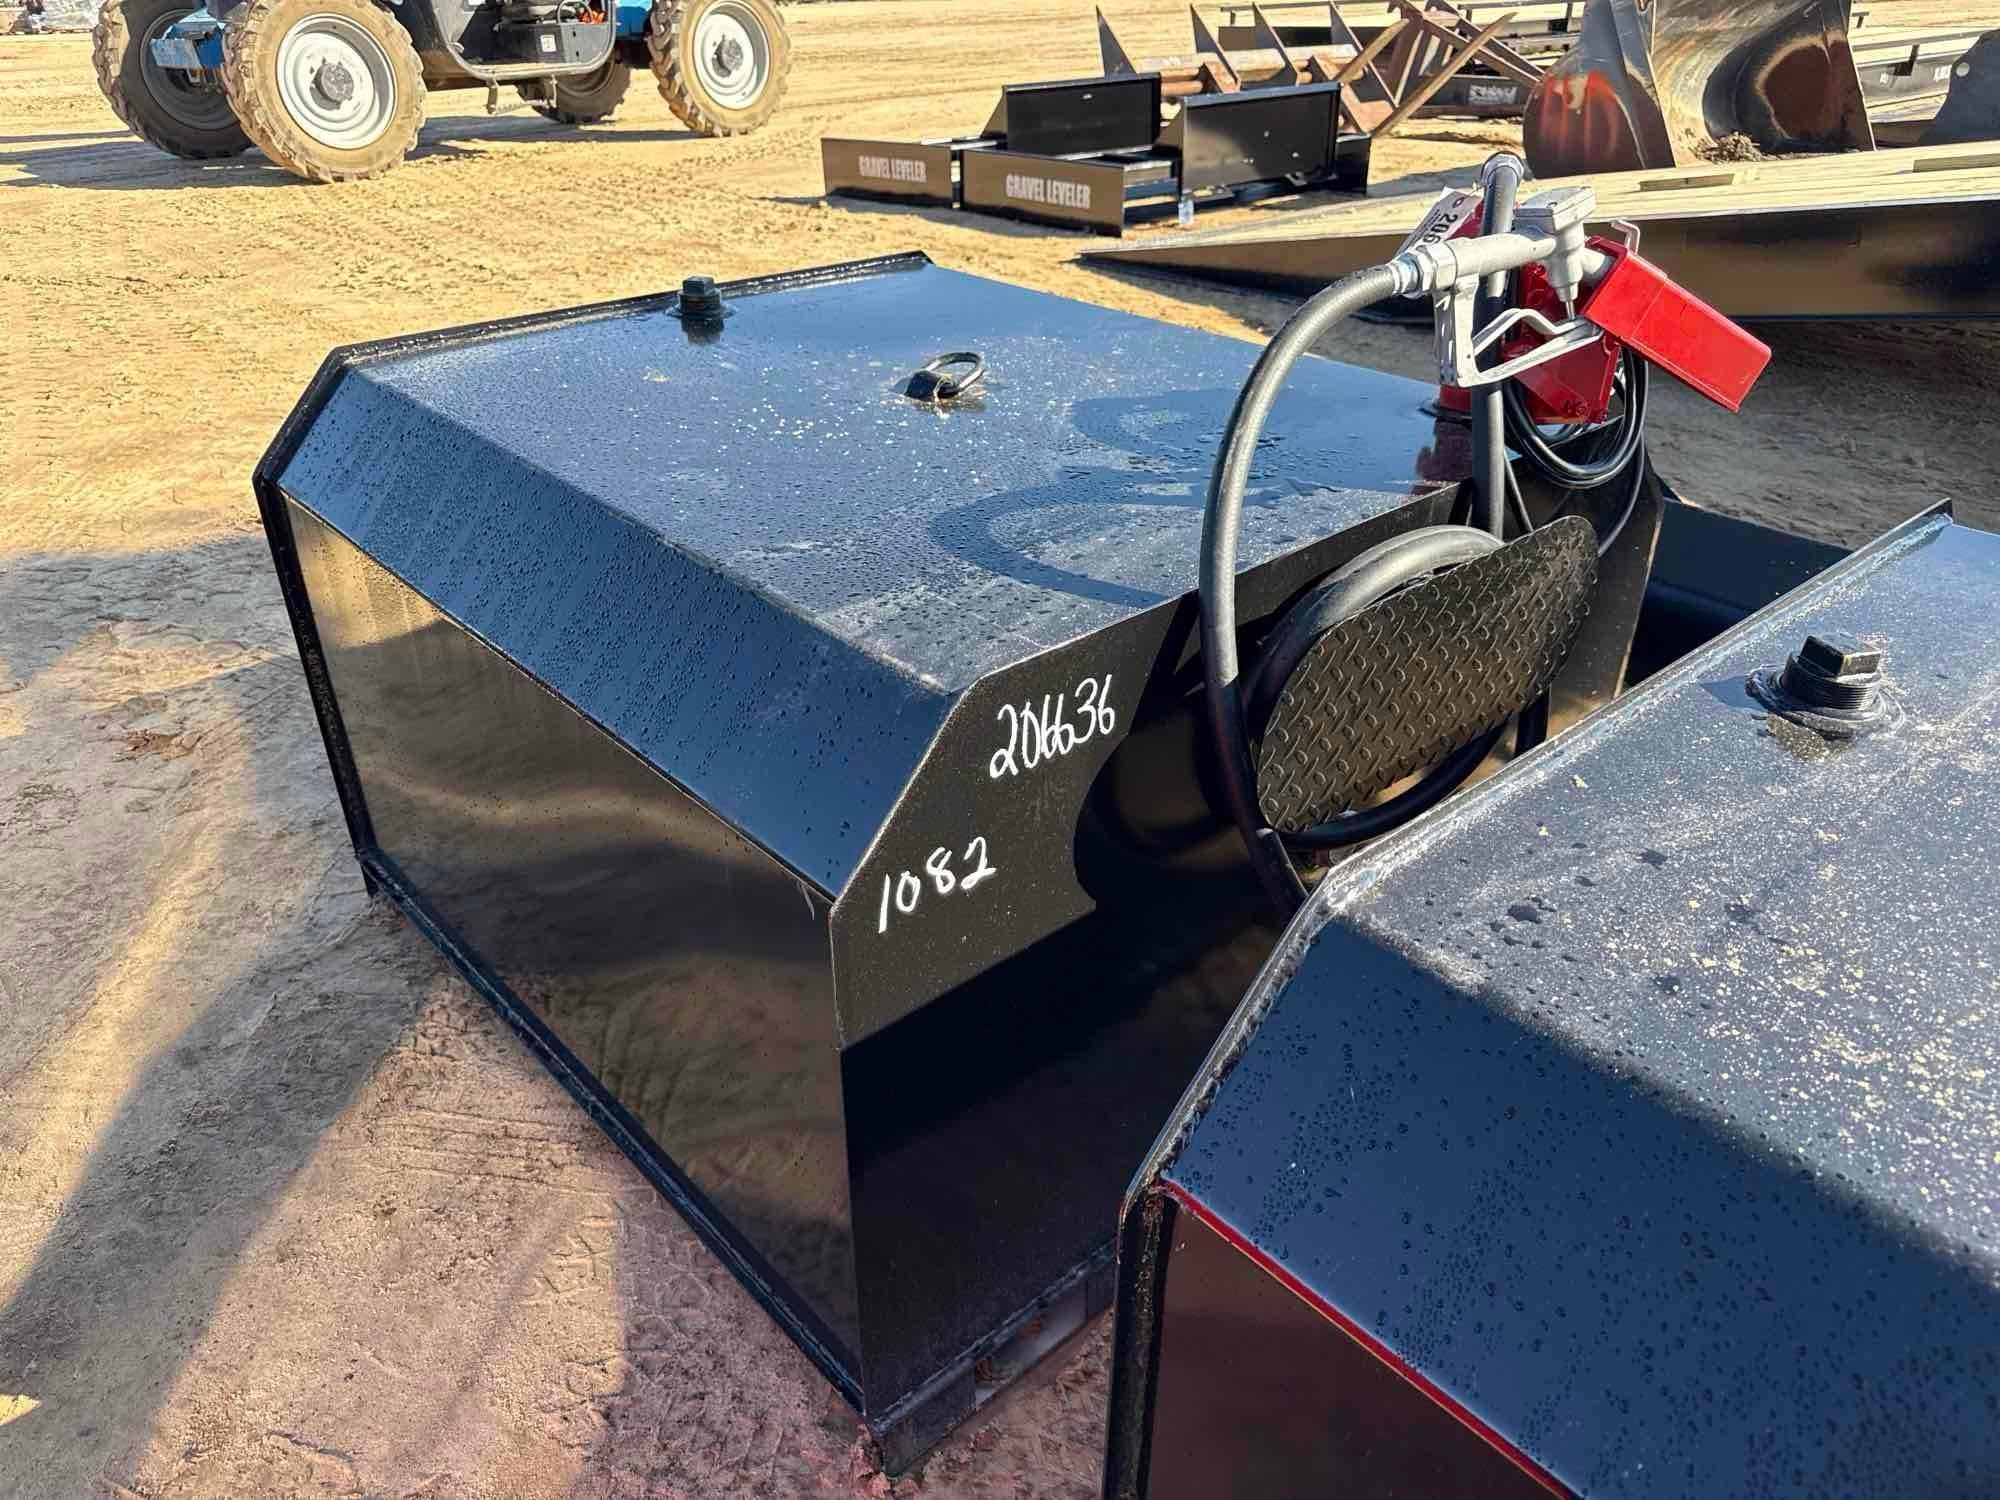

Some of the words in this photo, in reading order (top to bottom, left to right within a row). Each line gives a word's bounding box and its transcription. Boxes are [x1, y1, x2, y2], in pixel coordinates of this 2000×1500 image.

[859, 155, 890, 180] GRAVEL
[890, 159, 927, 183] LEVELER
[1006, 174, 1044, 202] GRAVEL
[1046, 179, 1090, 209] LEVELER
[989, 673, 1115, 778] 206636
[878, 836, 997, 934] 1082
